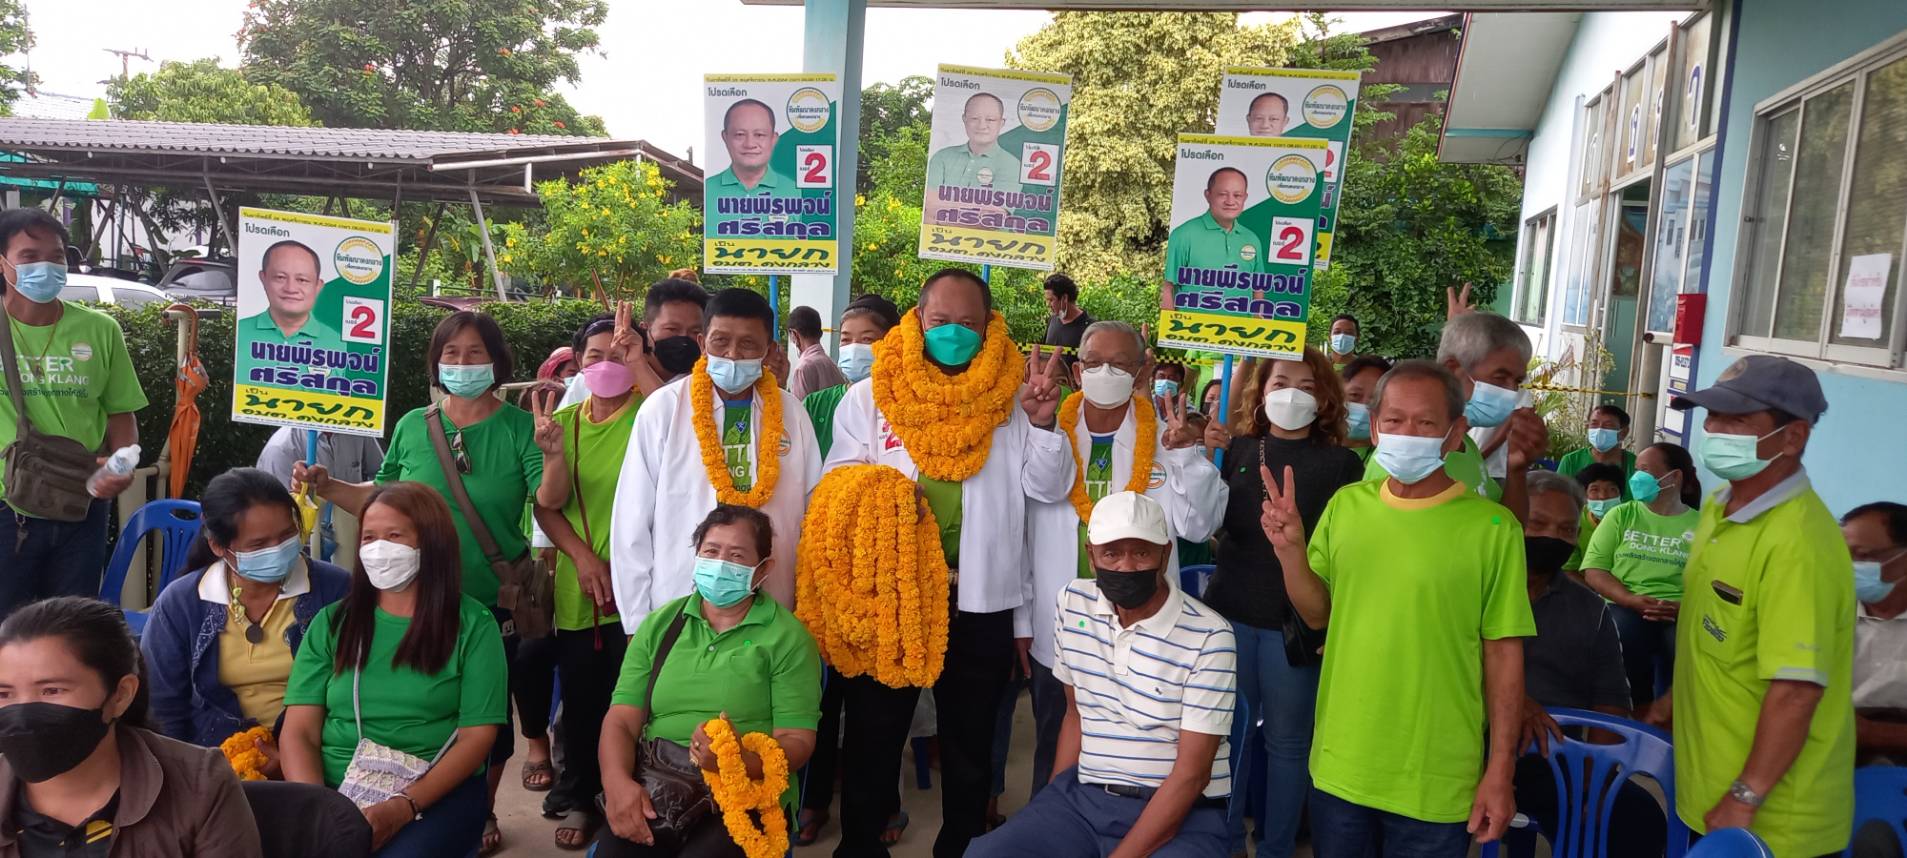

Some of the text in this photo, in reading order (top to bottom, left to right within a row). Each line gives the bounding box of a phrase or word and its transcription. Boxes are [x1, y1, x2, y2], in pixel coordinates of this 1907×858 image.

[708, 87, 747, 97] โปรดเลือก
[941, 77, 980, 90] โปรดเลือก
[1227, 78, 1266, 90] โปรดเลือก
[1028, 150, 1052, 181] 2
[1181, 148, 1224, 161] โปรดเลือก
[804, 152, 827, 183] 2
[717, 191, 832, 215] นายพีรพจน์
[938, 183, 1055, 212] นายพีรพจน์
[245, 222, 290, 238] โปรดเลือก
[717, 217, 831, 240] ศรีสกุล
[936, 207, 1049, 235] ศรีสกุล
[714, 247, 830, 260] นายก
[931, 233, 1046, 255] นายก
[1276, 226, 1305, 260] 2
[1178, 263, 1308, 295] นายพีรพจน์
[1175, 291, 1302, 320] ศรีสกุล
[350, 305, 376, 339] 2
[1169, 319, 1297, 343] นายก
[251, 340, 381, 373] นายพีรพจน์
[250, 366, 377, 397] ศรีสกุล
[245, 394, 374, 421] นายก
[1623, 529, 1681, 549] BETTER
[1630, 542, 1657, 553] DONG
